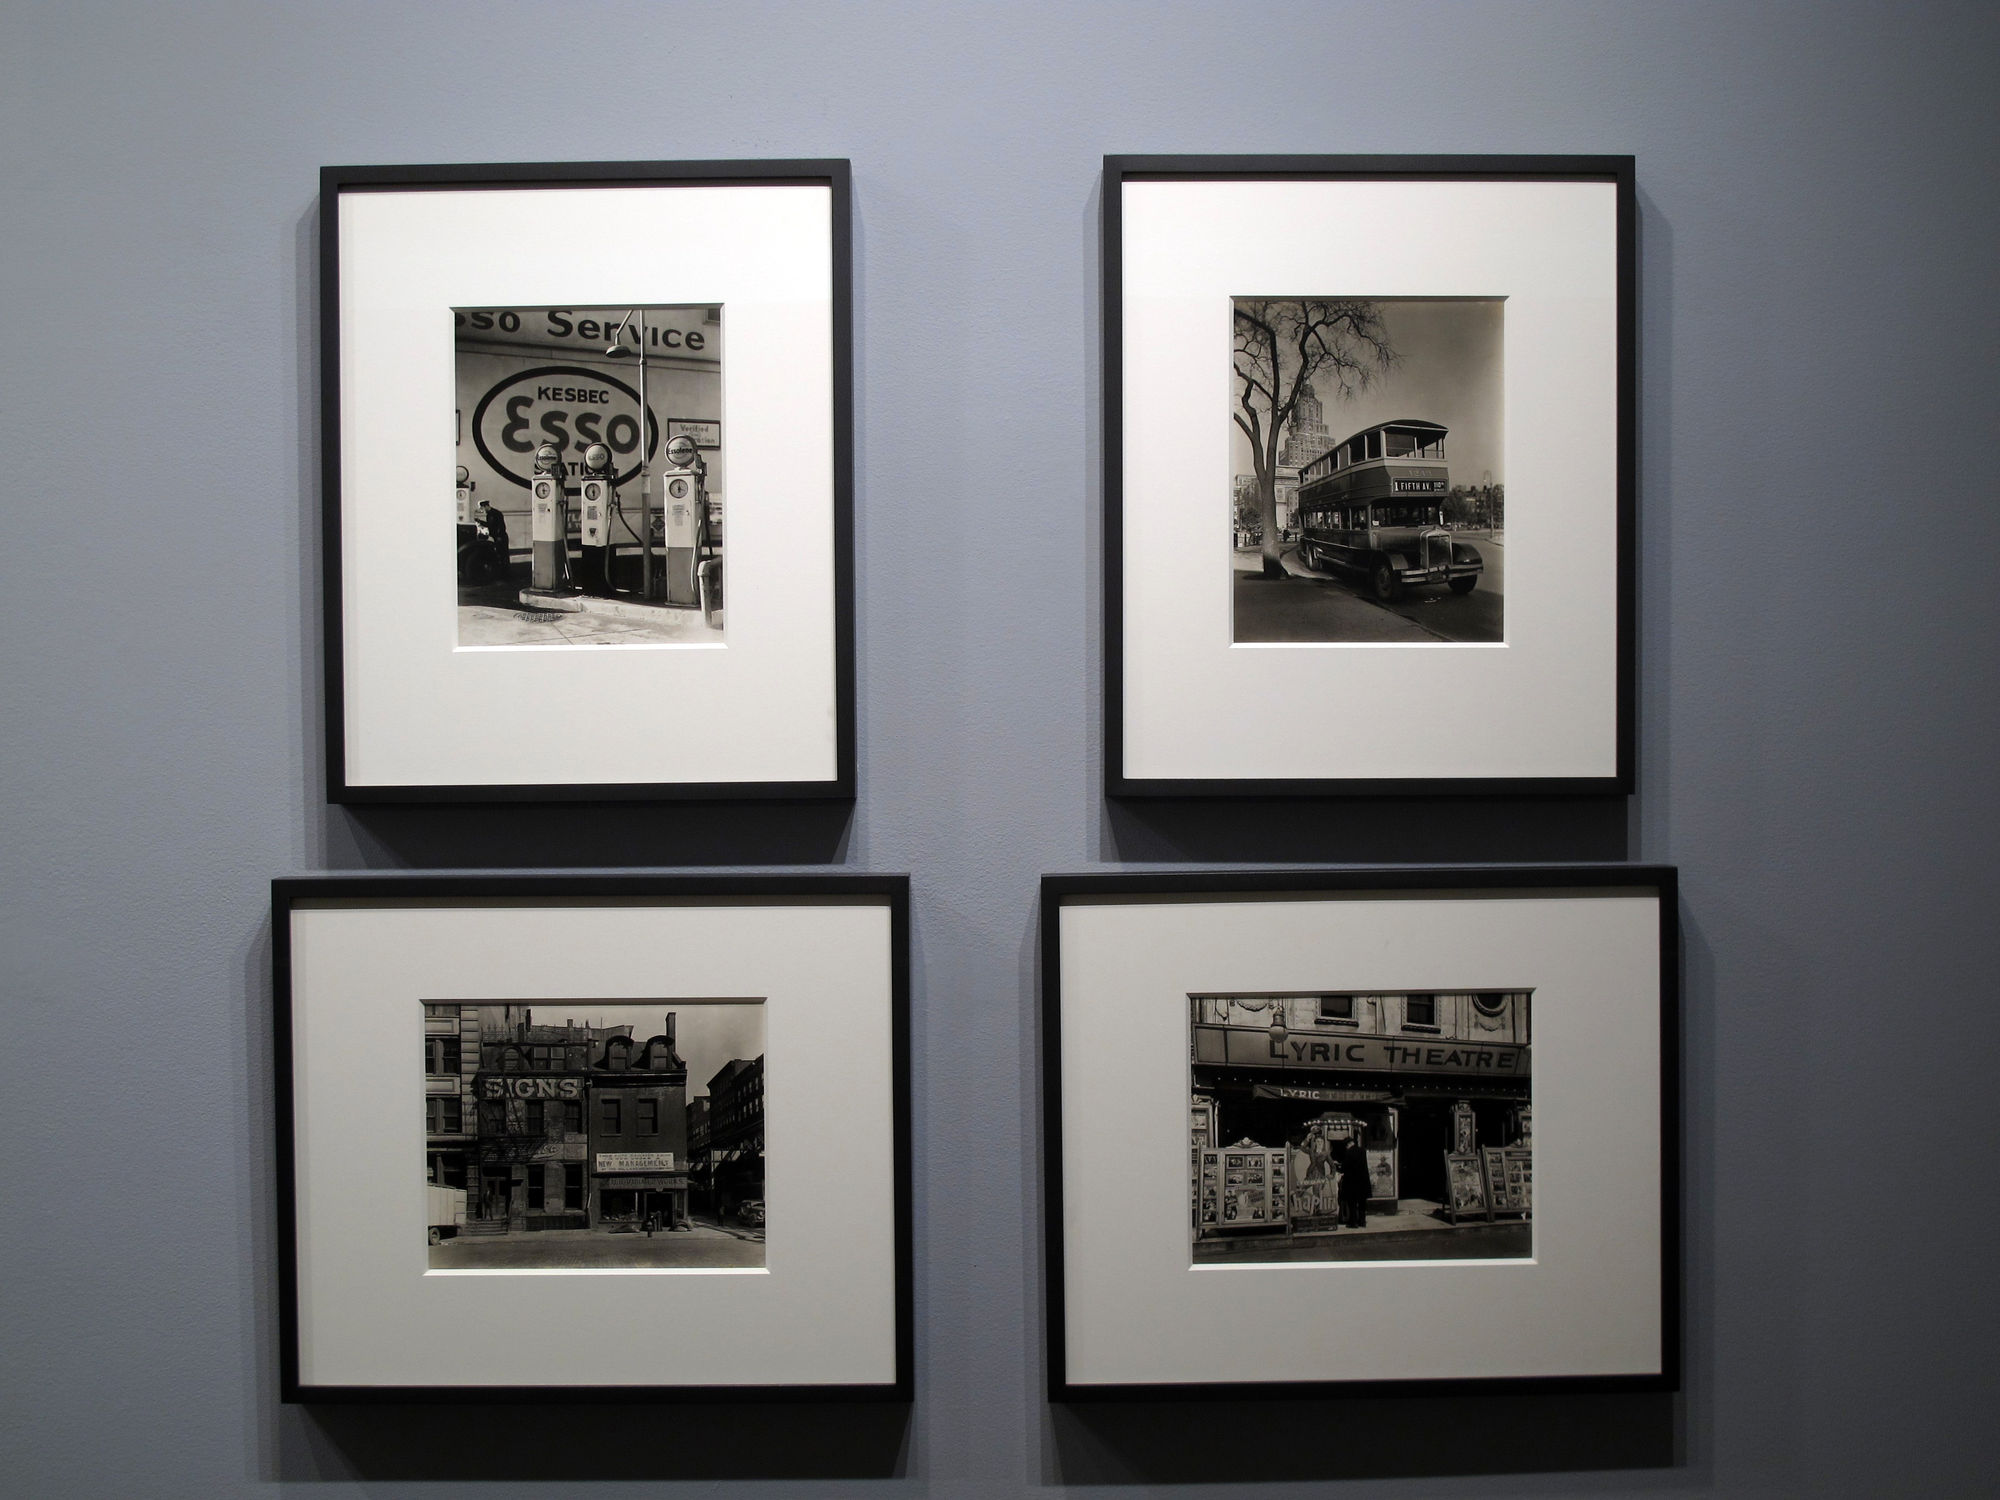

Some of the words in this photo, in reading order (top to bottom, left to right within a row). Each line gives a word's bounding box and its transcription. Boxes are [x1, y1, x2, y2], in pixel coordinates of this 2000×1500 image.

[547, 310, 706, 351] Service
[537, 386, 609, 404] KESBEC
[1400, 481, 1421, 491] FIFTH
[1269, 1039, 1365, 1063] LYRIC
[1383, 1045, 1515, 1069] THEATRE
[484, 1078, 578, 1098] SIGNS
[1280, 1088, 1320, 1099] LYRIC
[598, 1160, 613, 1168] NEW
[619, 1159, 669, 1168] MANAGEMENT
